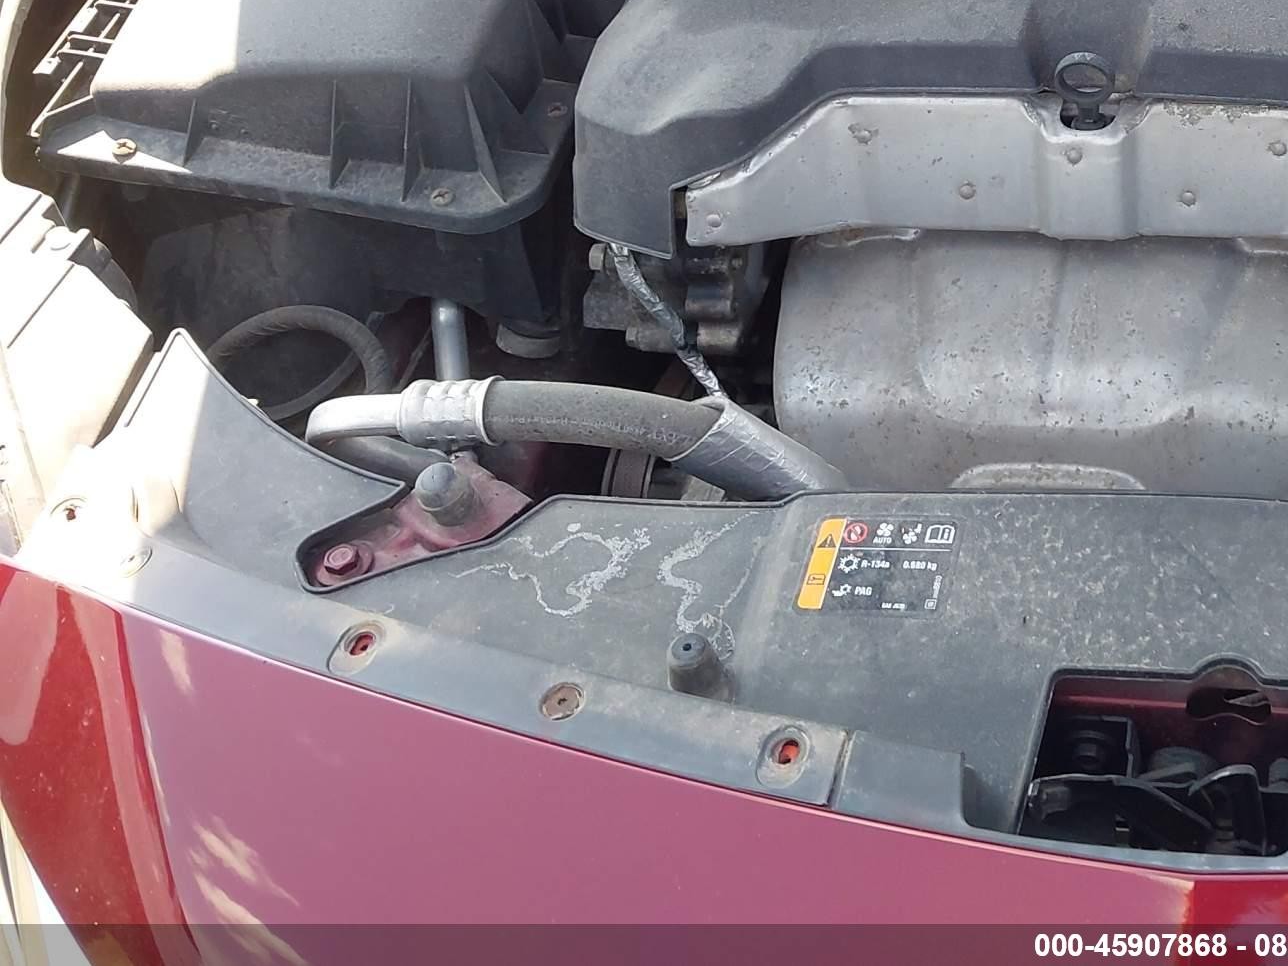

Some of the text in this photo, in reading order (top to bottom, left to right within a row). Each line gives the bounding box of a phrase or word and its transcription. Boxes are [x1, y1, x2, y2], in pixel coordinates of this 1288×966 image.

[872, 536, 892, 544] AUTO
[860, 559, 890, 569] R-134a
[926, 561, 938, 572] kg
[854, 586, 873, 596] PAG
